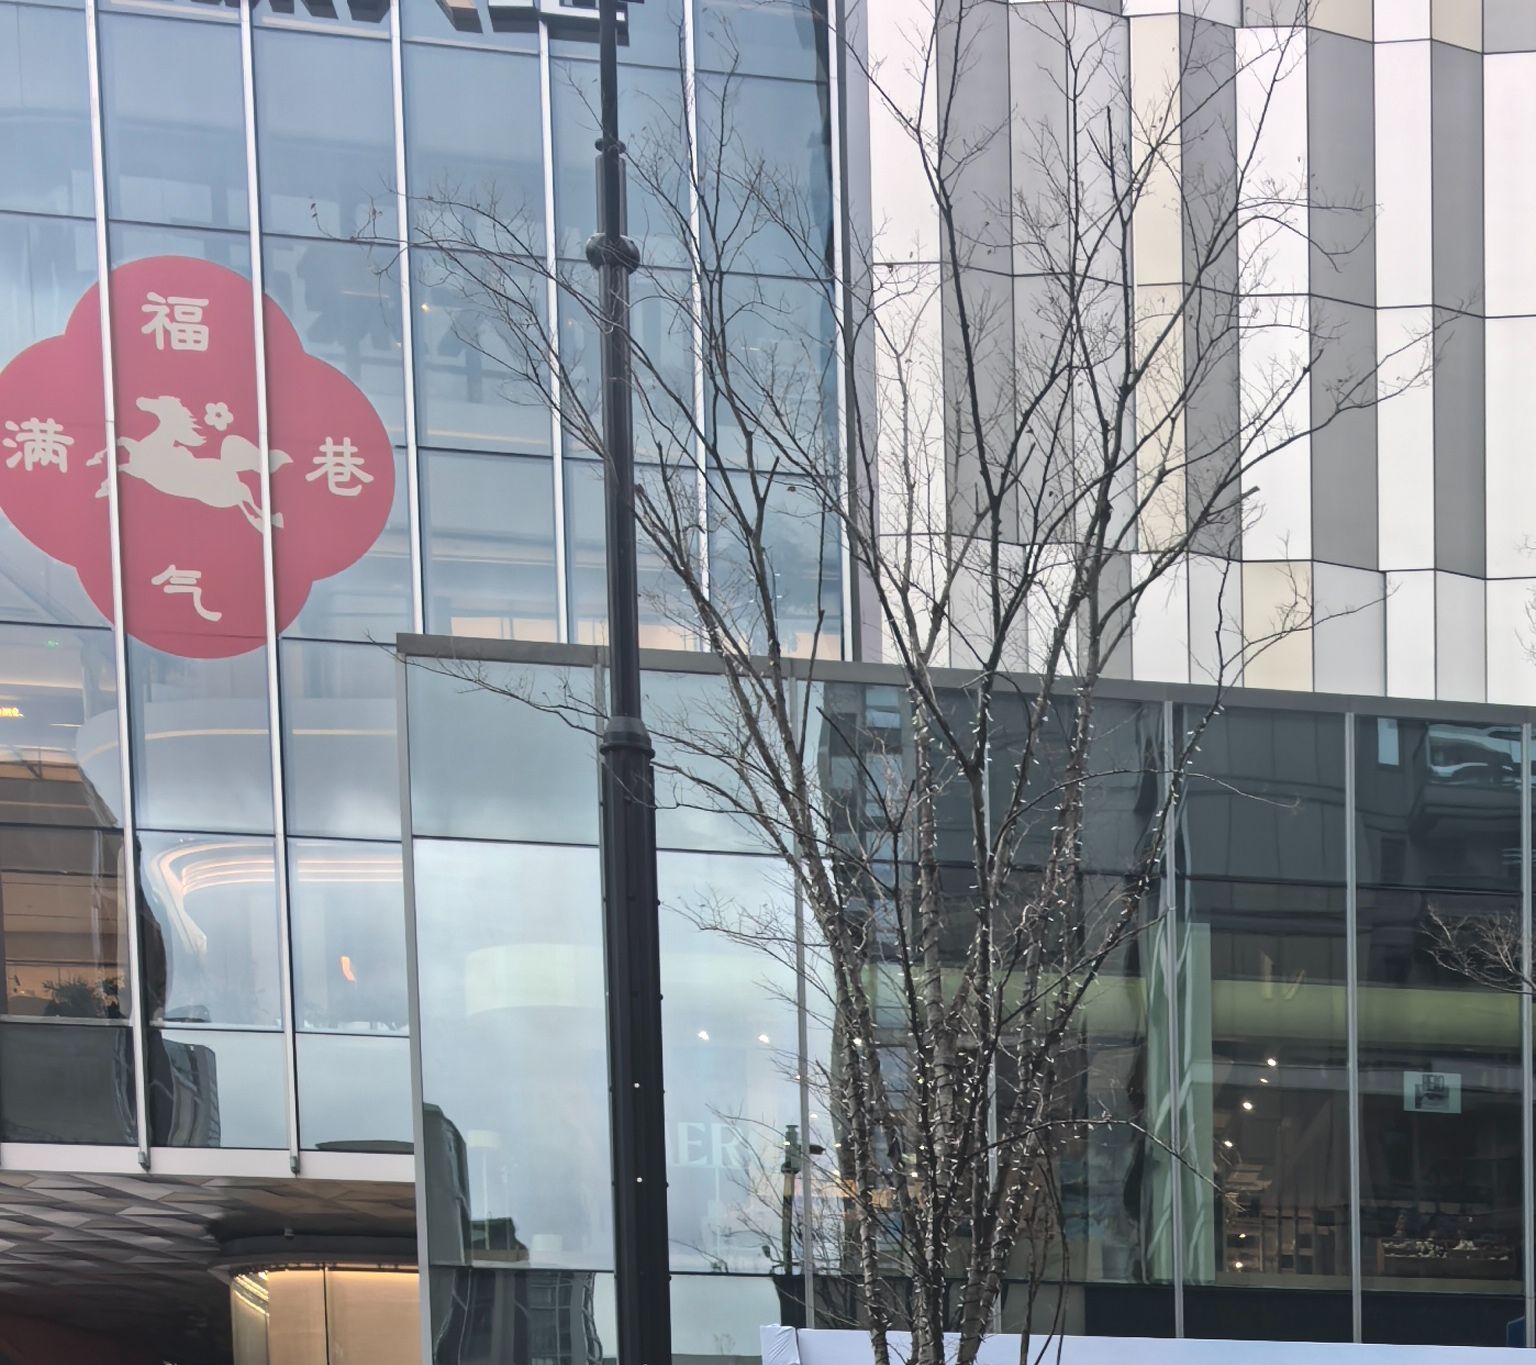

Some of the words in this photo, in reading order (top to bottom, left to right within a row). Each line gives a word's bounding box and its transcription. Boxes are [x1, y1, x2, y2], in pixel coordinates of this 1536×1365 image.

[141, 291, 209, 352] 福
[2, 417, 75, 473] 满
[304, 436, 374, 497] 巷
[151, 564, 222, 622] 气
